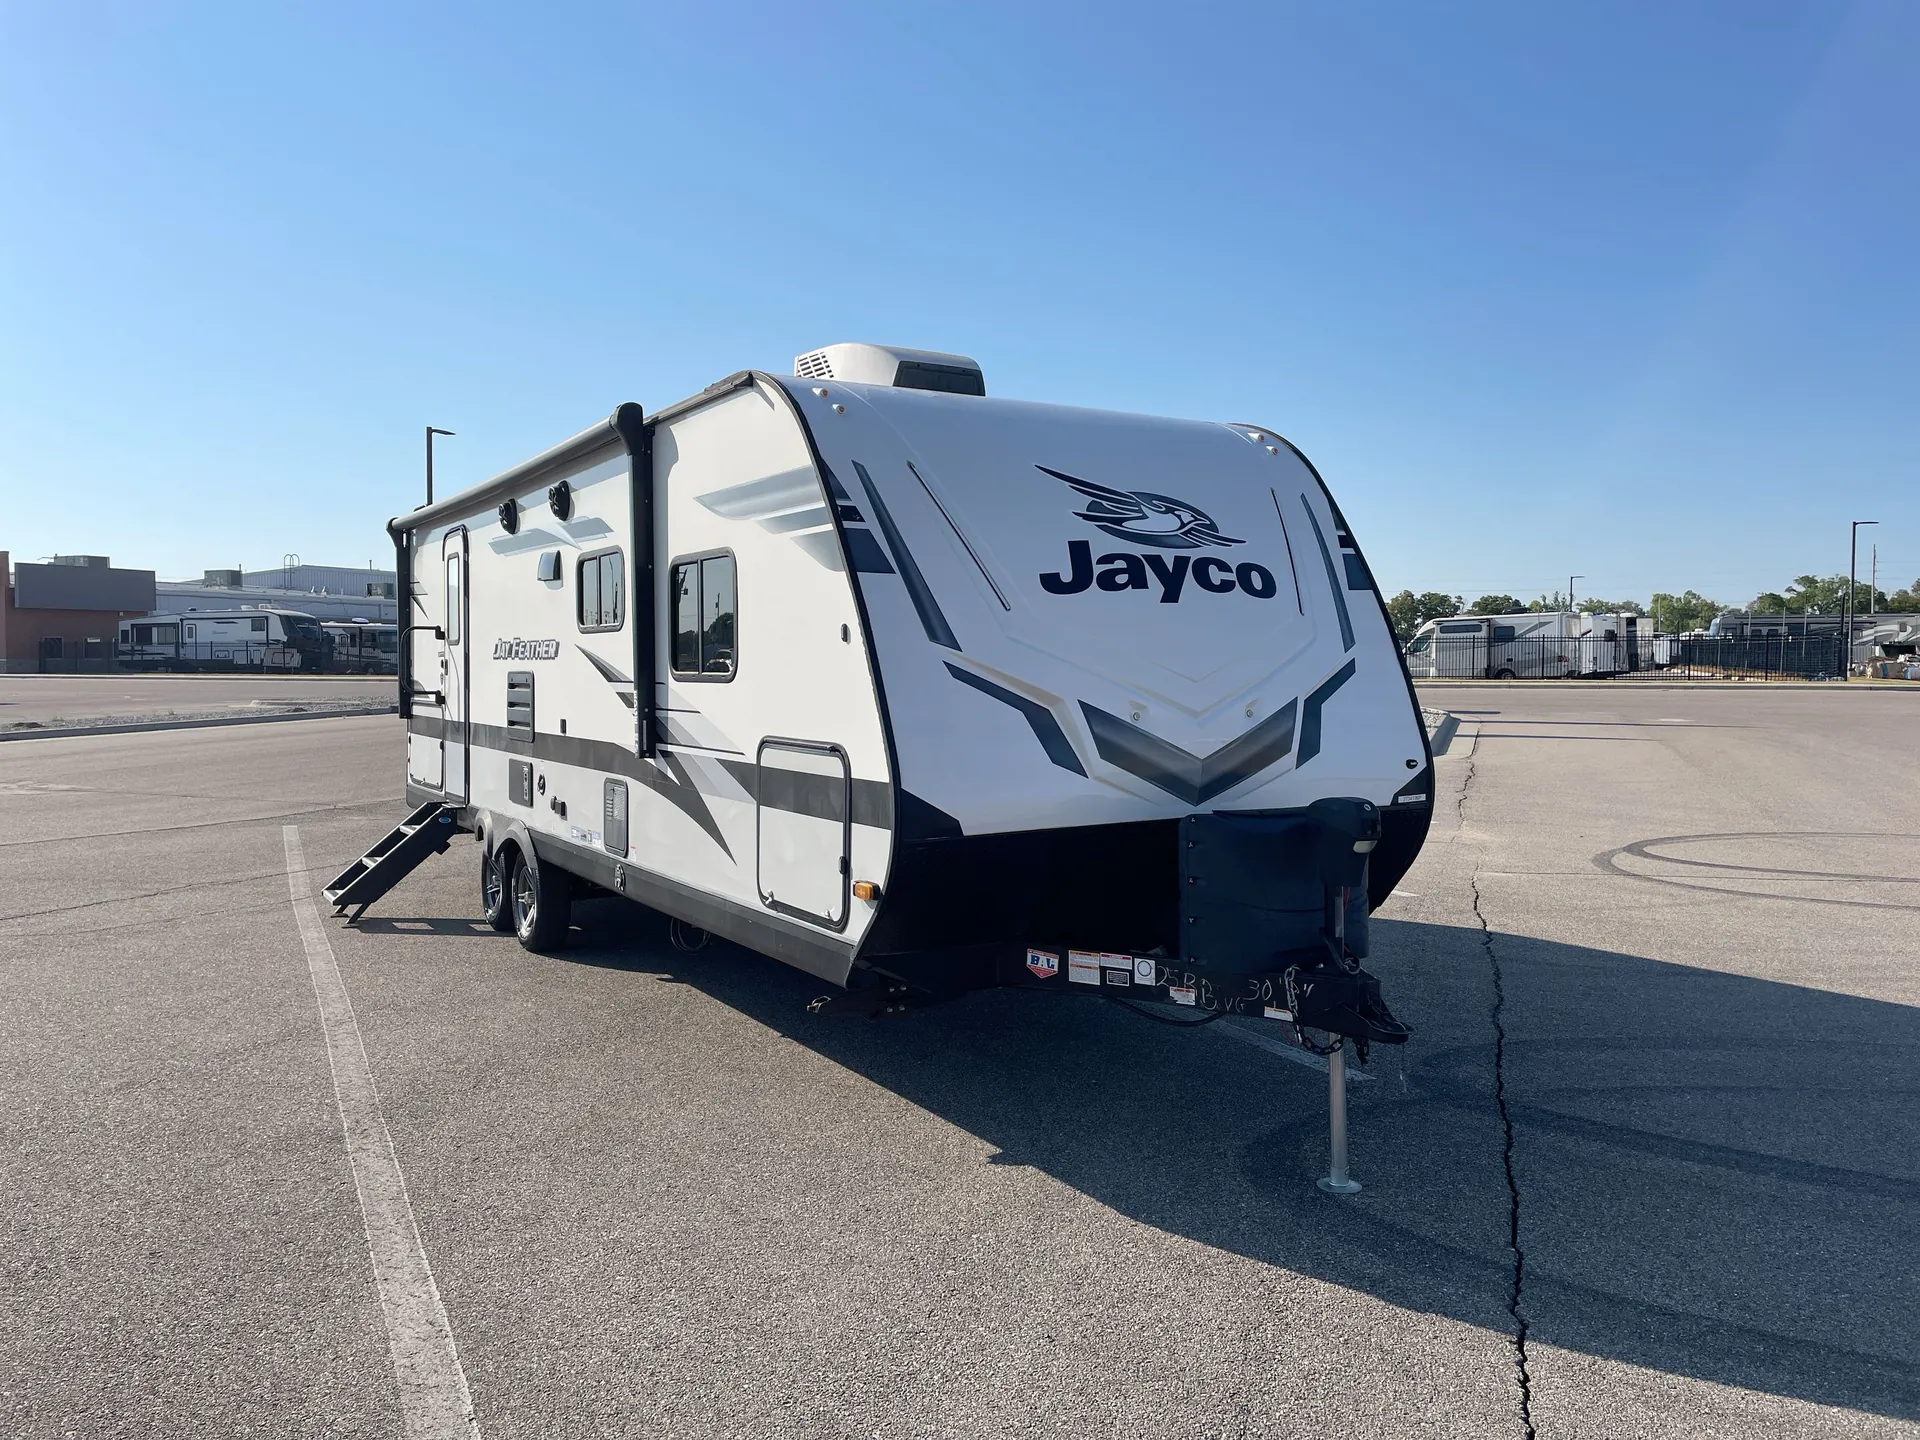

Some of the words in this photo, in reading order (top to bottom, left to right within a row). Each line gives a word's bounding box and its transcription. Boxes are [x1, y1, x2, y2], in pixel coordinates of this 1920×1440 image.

[1039, 539, 1277, 604] Jayco
[492, 637, 512, 660] JAY
[511, 637, 560, 660] FEATHER
